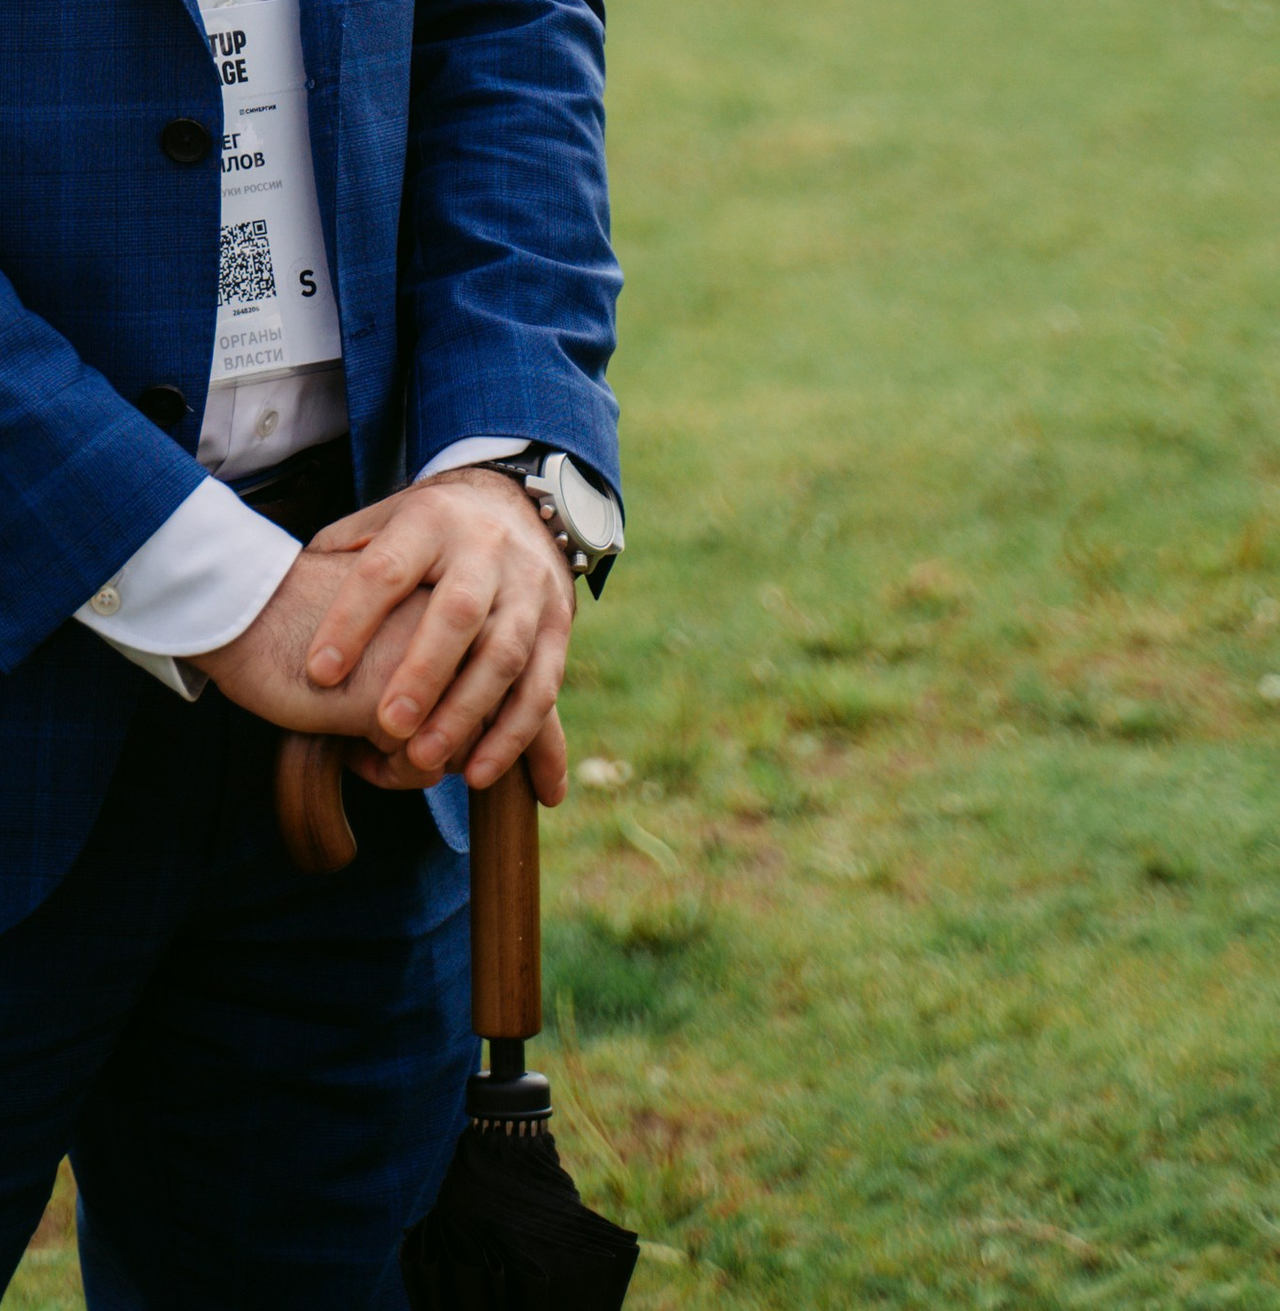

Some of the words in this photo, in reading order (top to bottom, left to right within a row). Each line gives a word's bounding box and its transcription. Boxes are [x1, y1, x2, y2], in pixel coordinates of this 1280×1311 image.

[244, 180, 283, 194] РОССИИ
[299, 269, 317, 297] S
[220, 327, 282, 350] ОРГАНЫ
[224, 347, 283, 371] ВЛАСТИ
